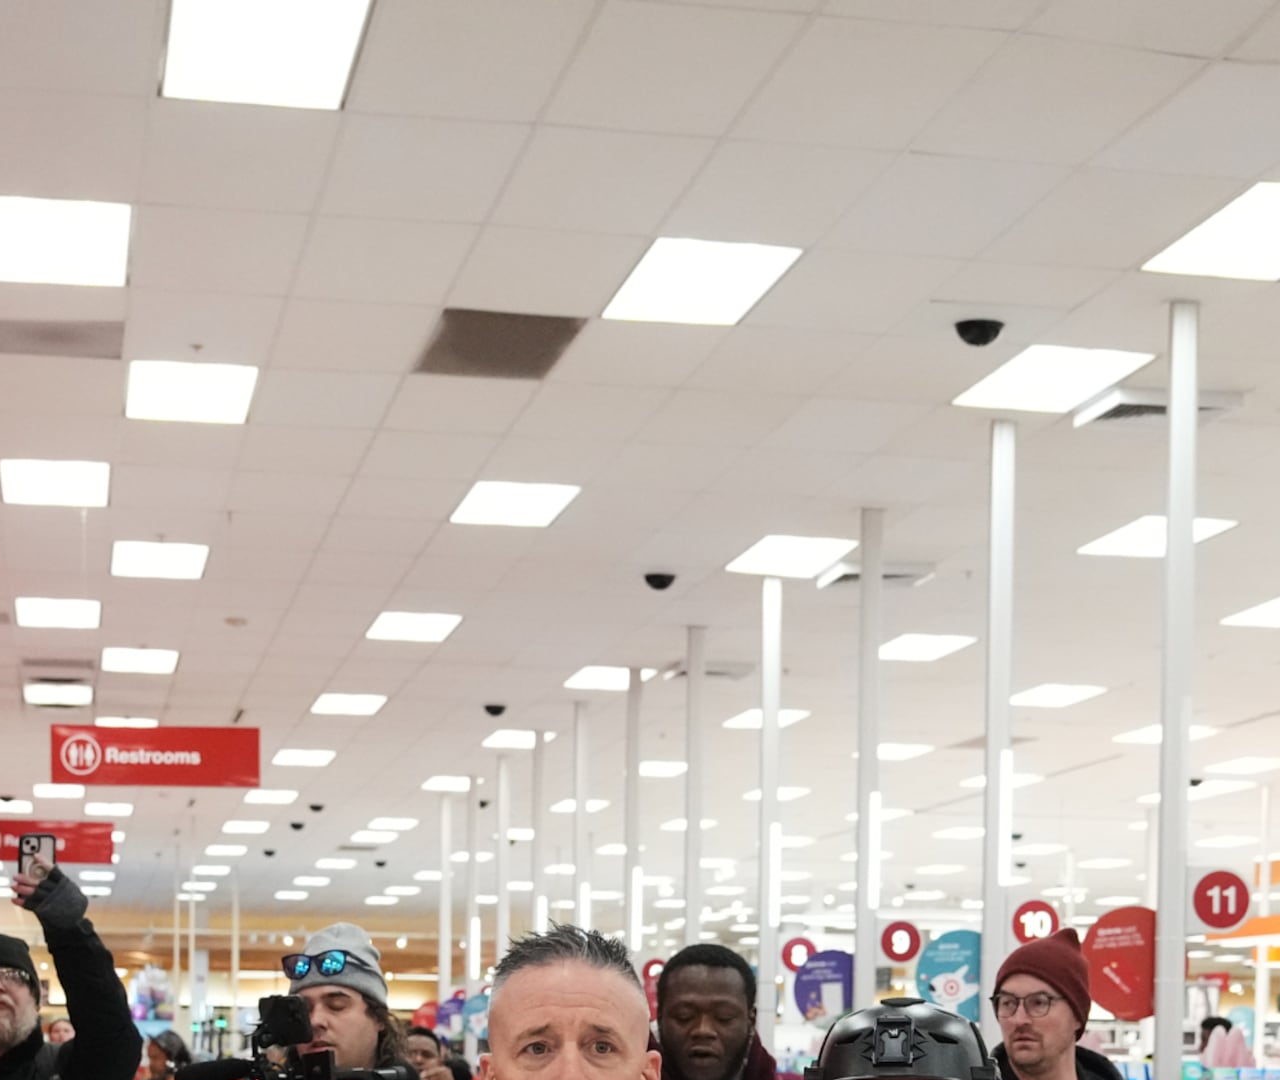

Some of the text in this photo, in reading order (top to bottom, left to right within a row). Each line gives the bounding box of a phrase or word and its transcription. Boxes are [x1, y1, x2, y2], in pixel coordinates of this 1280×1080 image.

[104, 748, 201, 766] Restrooms
[1206, 886, 1238, 915] 11
[1021, 911, 1053, 937] 10
[891, 930, 911, 955] 9
[790, 944, 809, 967] 8
